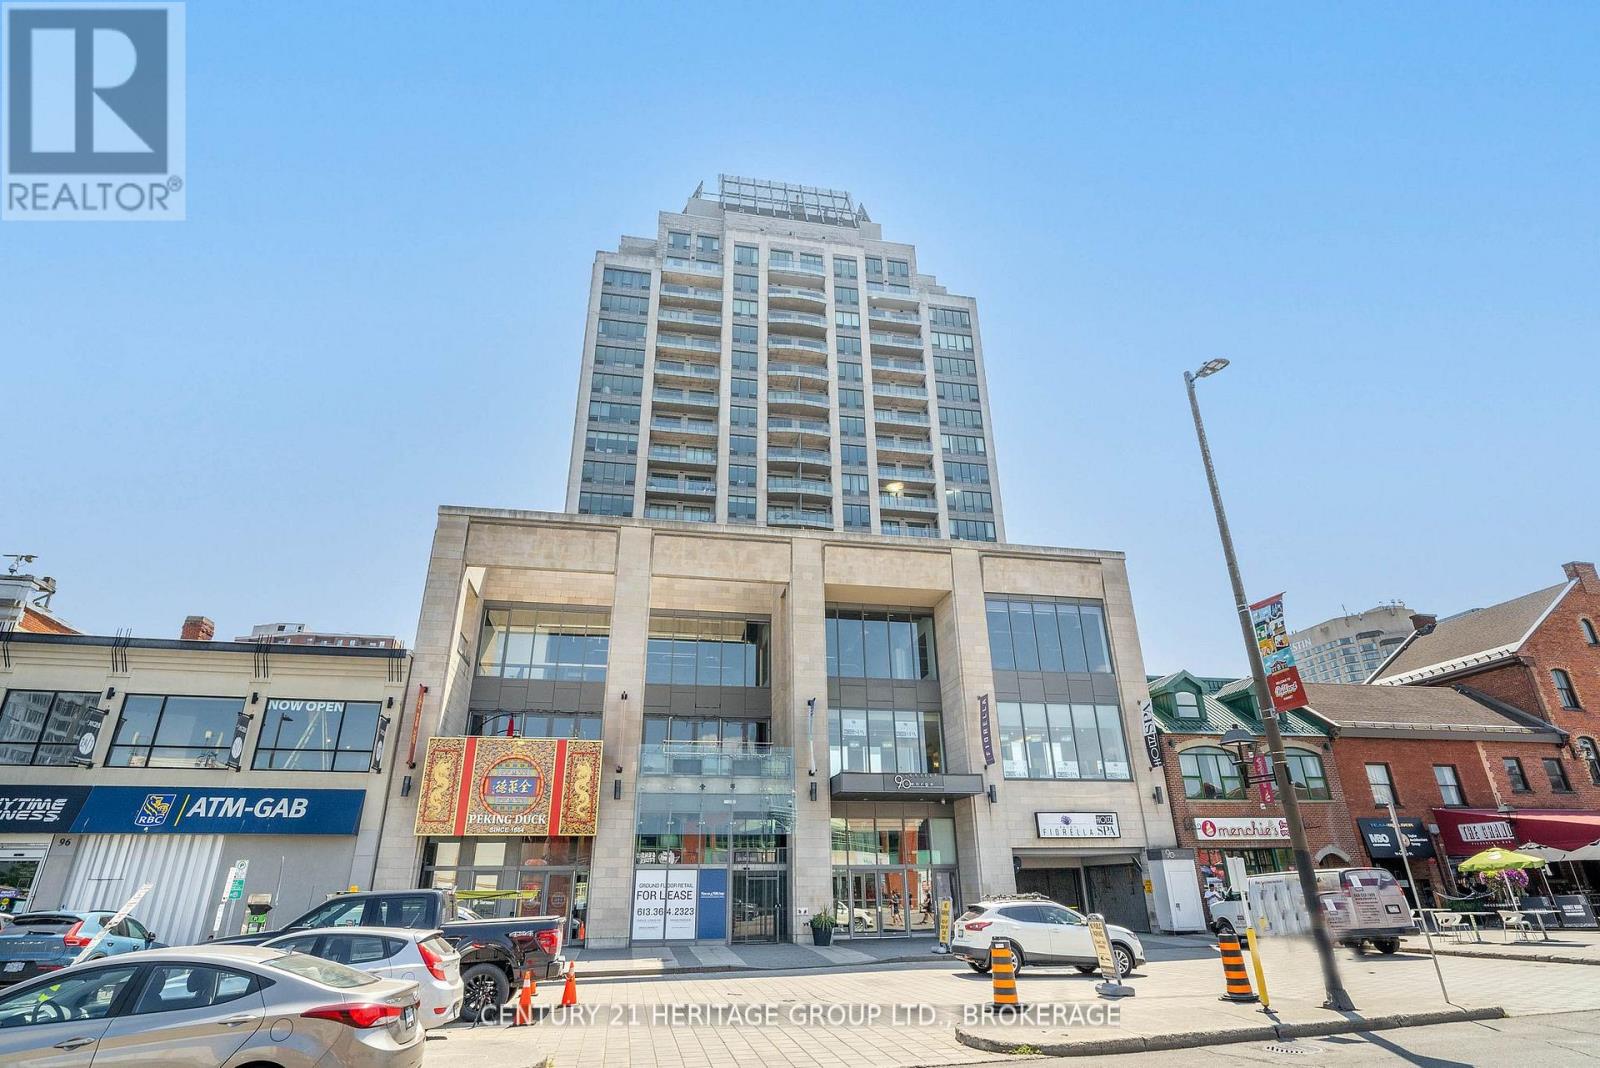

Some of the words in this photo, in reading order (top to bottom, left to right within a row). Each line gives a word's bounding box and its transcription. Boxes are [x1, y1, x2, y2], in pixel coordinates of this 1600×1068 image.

[268, 701, 303, 711] NOW
[305, 702, 345, 712] OPEN
[894, 774, 912, 790] 90
[186, 797, 309, 819] ATM-GAB
[138, 815, 164, 824] RBC
[468, 814, 512, 824] PEKING
[514, 814, 546, 825] DUCK
[1042, 828, 1095, 837] FIORELLA
[1097, 826, 1116, 836] SPA
[1218, 820, 1279, 837] menchie's
[1461, 825, 1481, 840] THE
[59, 838, 71, 846] 96
[636, 890, 657, 900] FOR
[659, 890, 693, 900] LEASE
[637, 907, 695, 916] 613.364.2323
